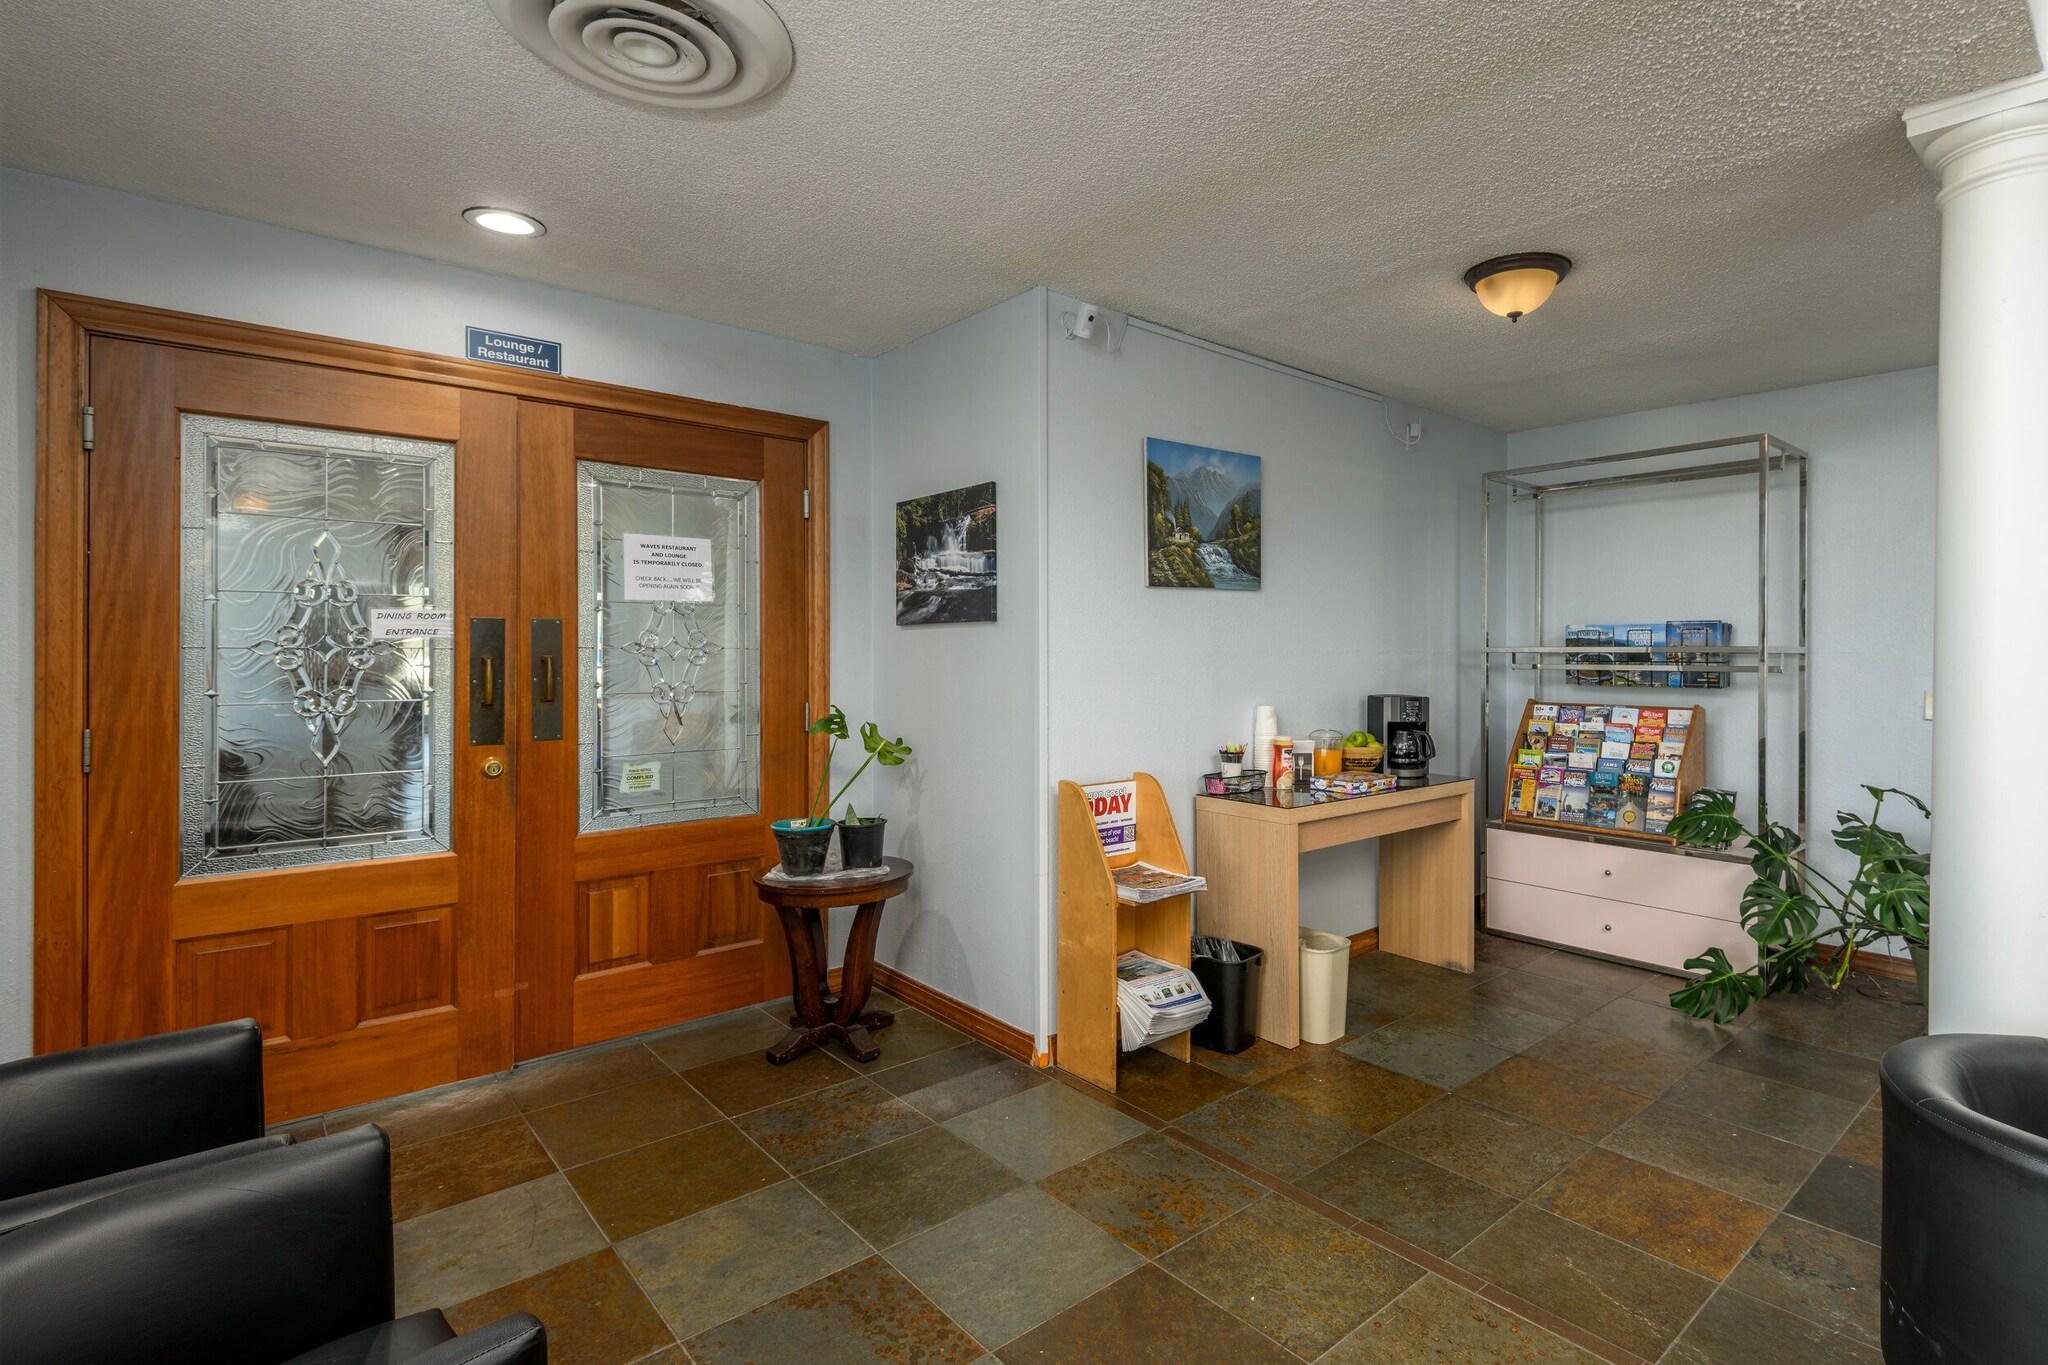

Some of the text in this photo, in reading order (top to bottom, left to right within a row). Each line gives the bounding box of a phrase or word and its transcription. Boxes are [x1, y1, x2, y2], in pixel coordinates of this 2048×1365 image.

[485, 335, 543, 355] Lounge /
[477, 346, 550, 368] Restaurant
[641, 559, 680, 567] TEMPORARILY
[376, 612, 447, 620] DINING ROOM
[385, 628, 440, 636] ENTRANCE
